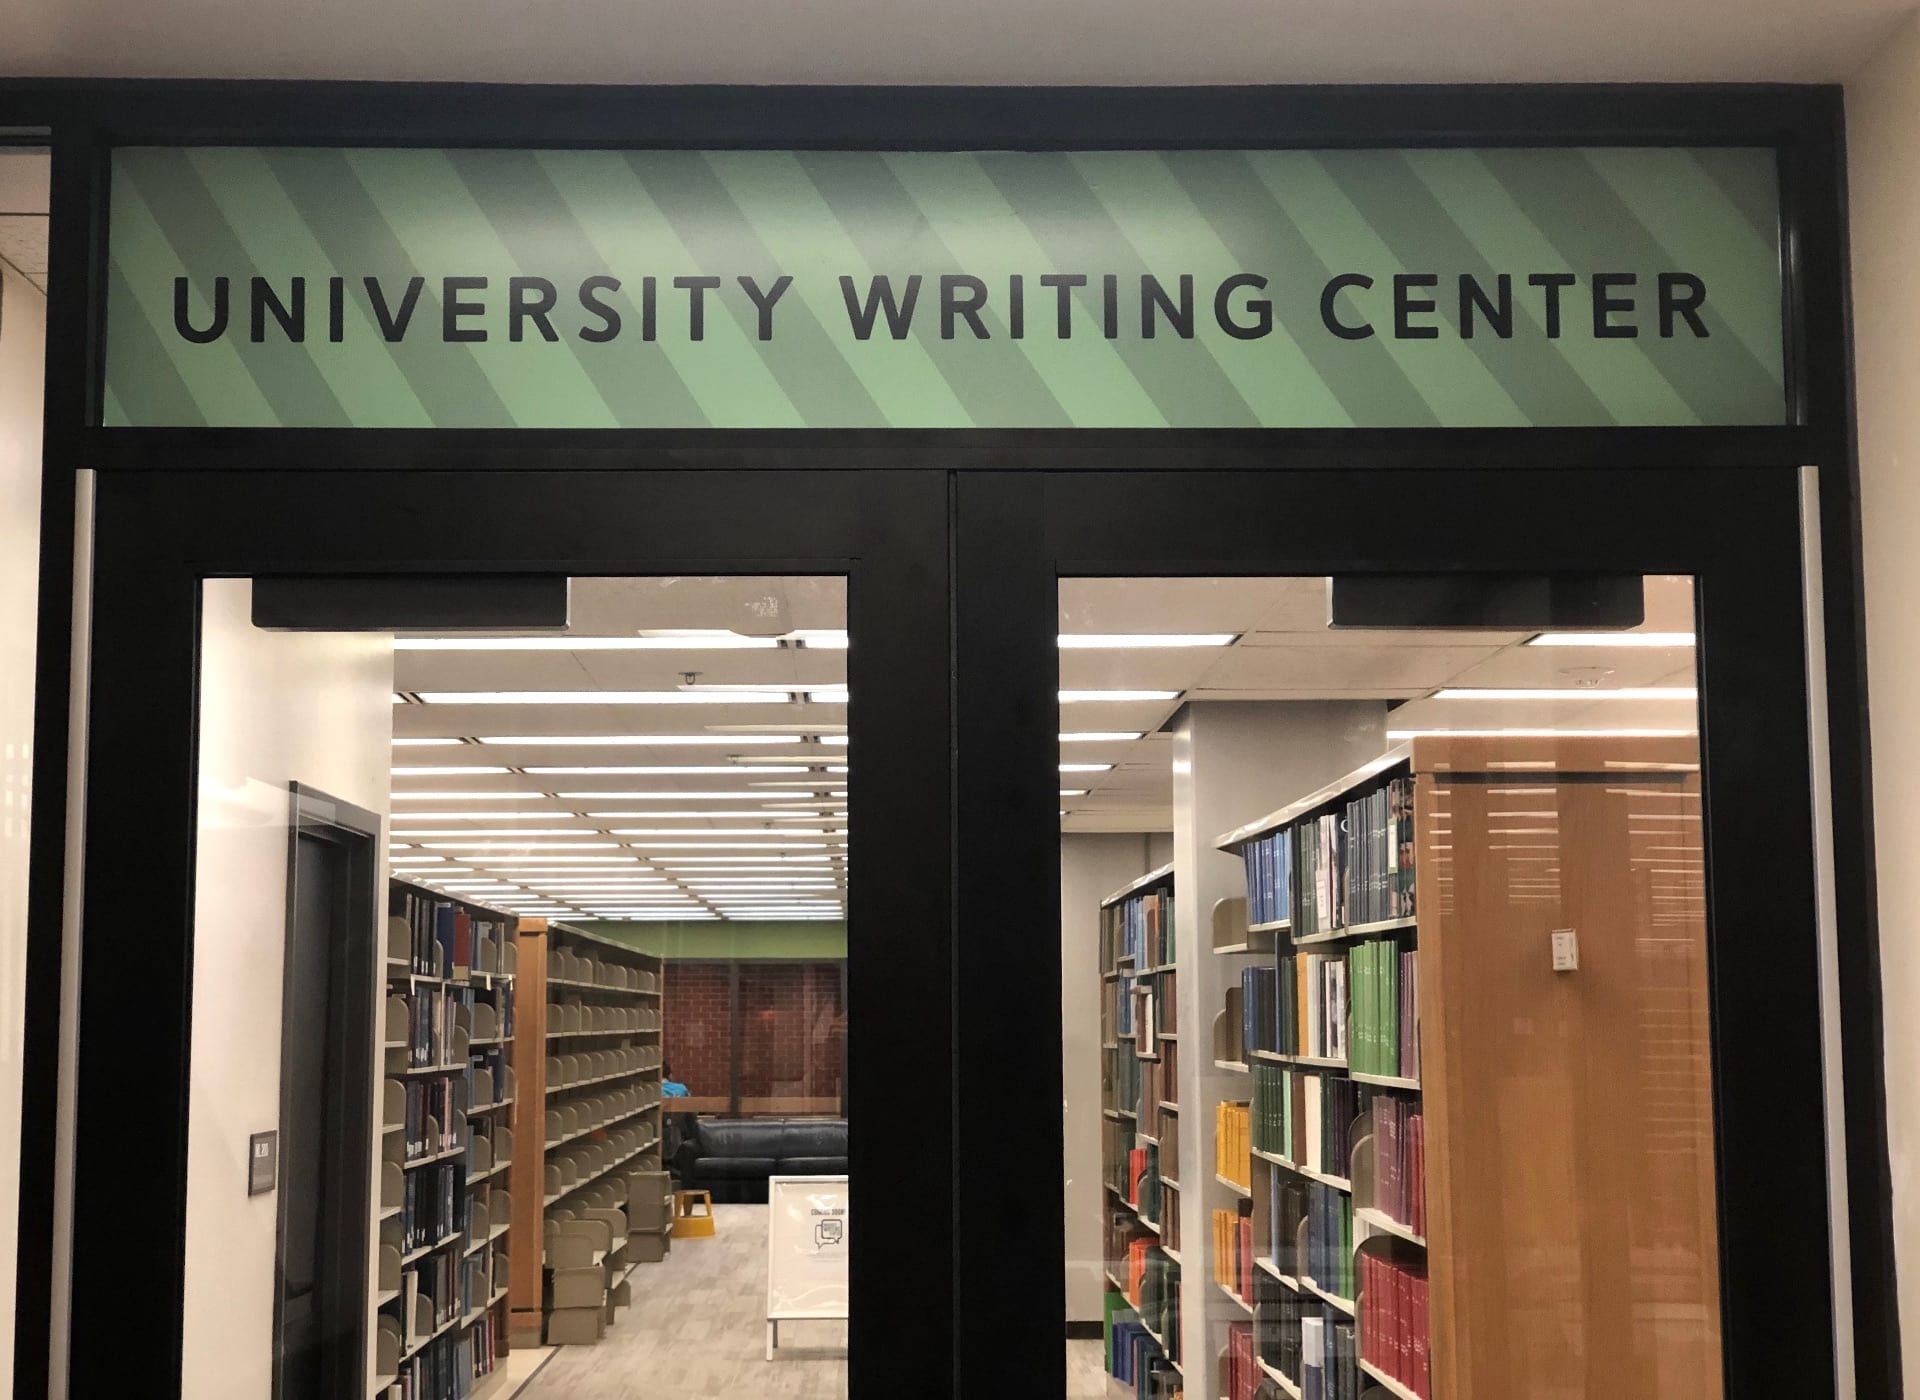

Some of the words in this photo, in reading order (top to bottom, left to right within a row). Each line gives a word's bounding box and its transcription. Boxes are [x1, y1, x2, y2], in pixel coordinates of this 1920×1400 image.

[173, 275, 795, 344] UNIVERSITY
[839, 273, 1273, 341] WRITING
[1319, 272, 1712, 340] CENTER
